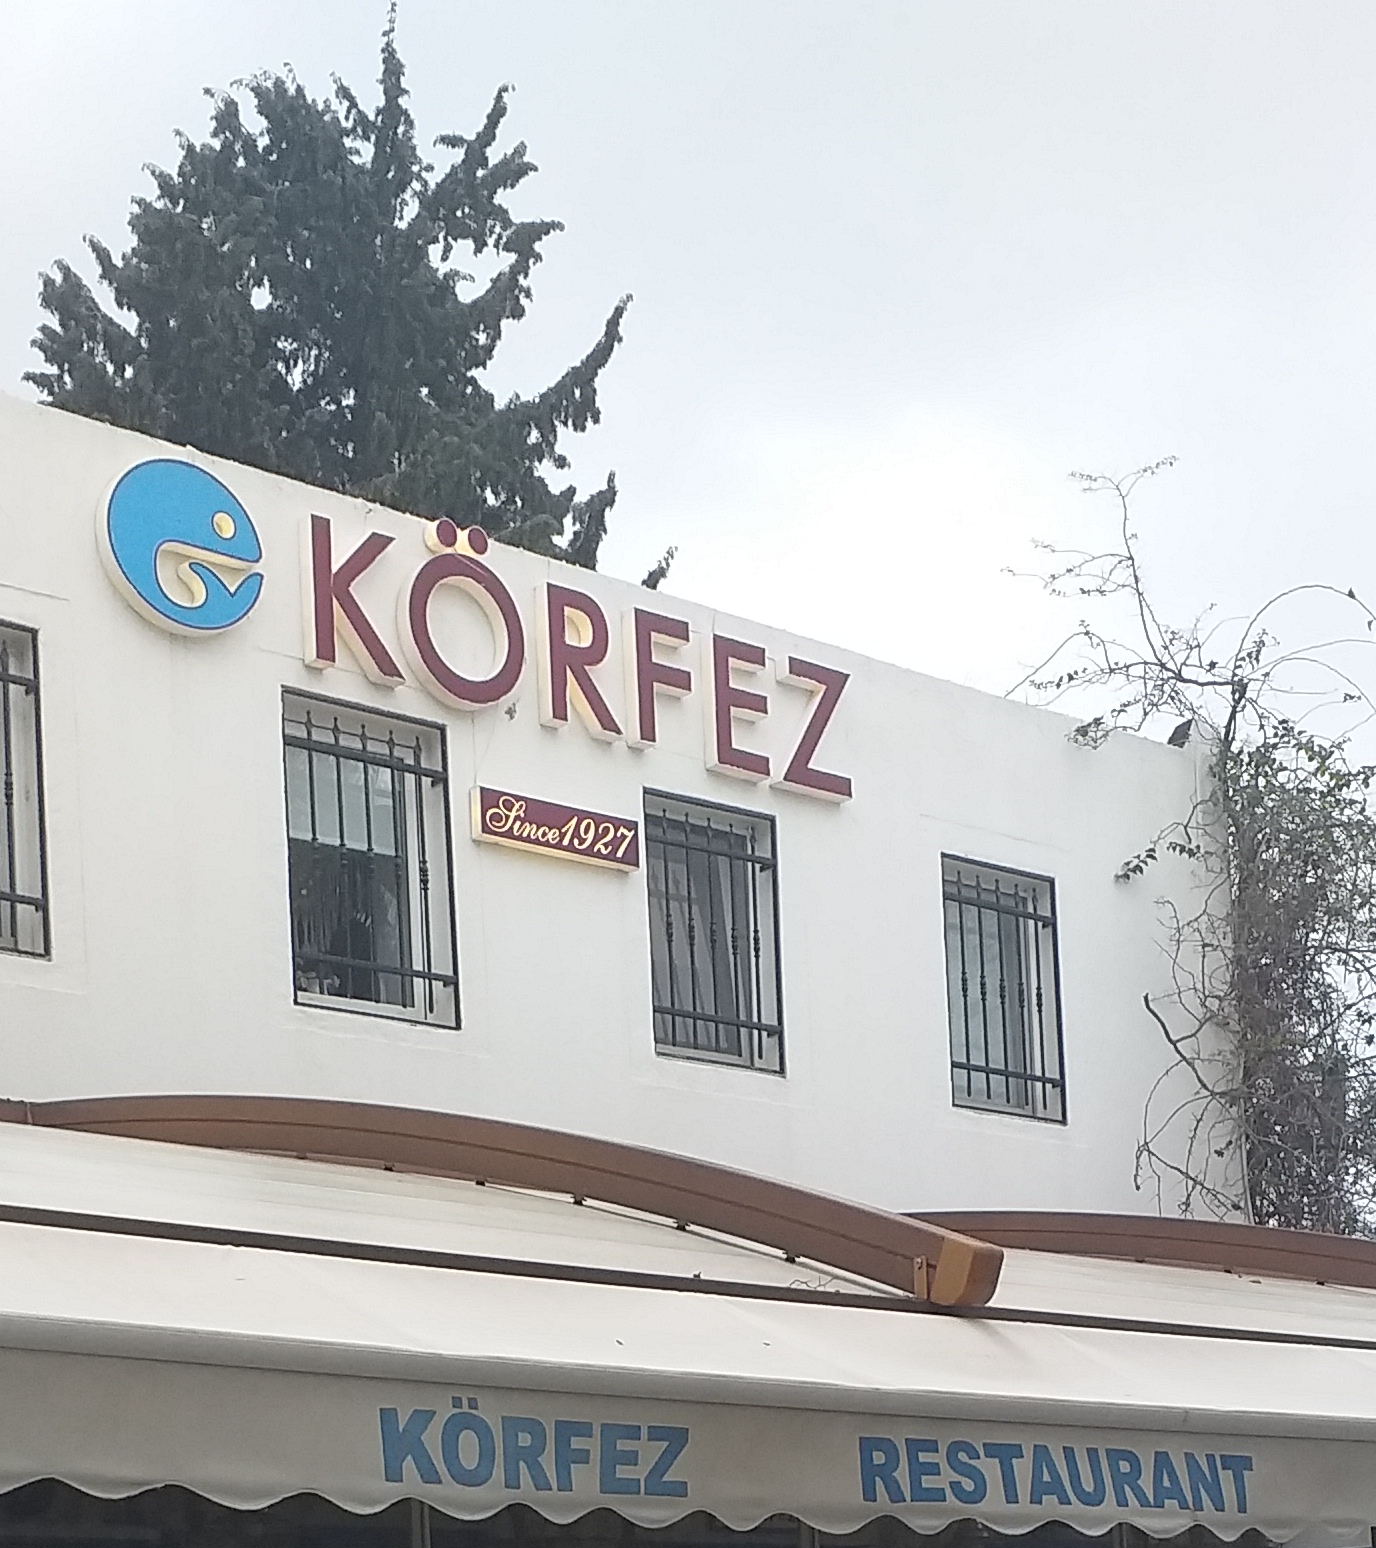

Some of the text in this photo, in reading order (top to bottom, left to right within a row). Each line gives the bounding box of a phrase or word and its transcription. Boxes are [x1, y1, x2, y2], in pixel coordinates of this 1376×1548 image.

[305, 514, 853, 802] KÖRFEZ
[379, 1397, 1254, 1514] KÖRFEZ RESTAURANT
